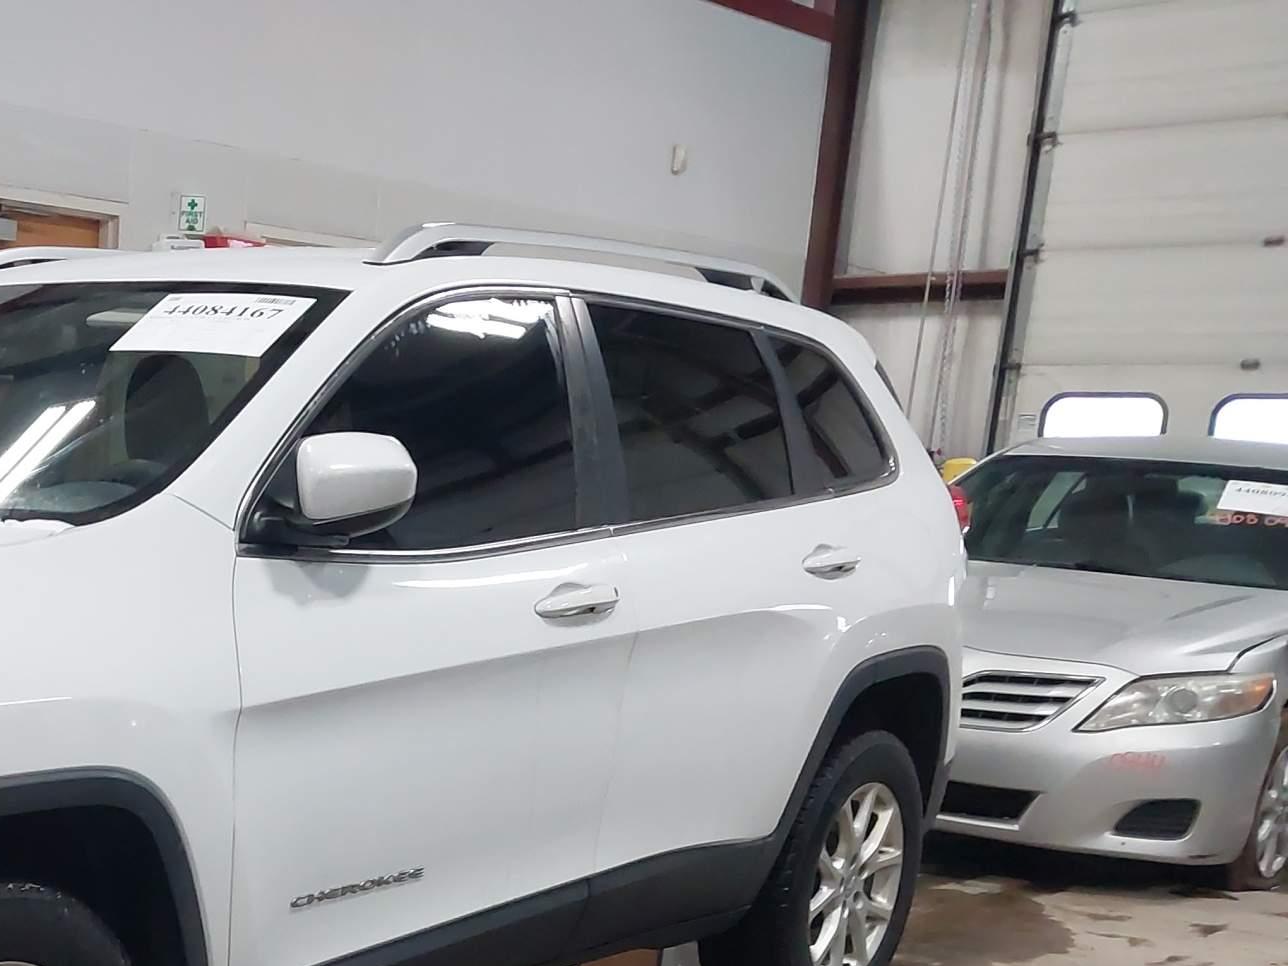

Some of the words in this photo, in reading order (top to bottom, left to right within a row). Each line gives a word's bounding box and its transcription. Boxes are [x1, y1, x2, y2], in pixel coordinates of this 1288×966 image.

[181, 210, 202, 218] FIRST
[185, 217, 199, 225] AID
[164, 304, 284, 320] 44084167
[290, 866, 425, 908] CHEROKEE
